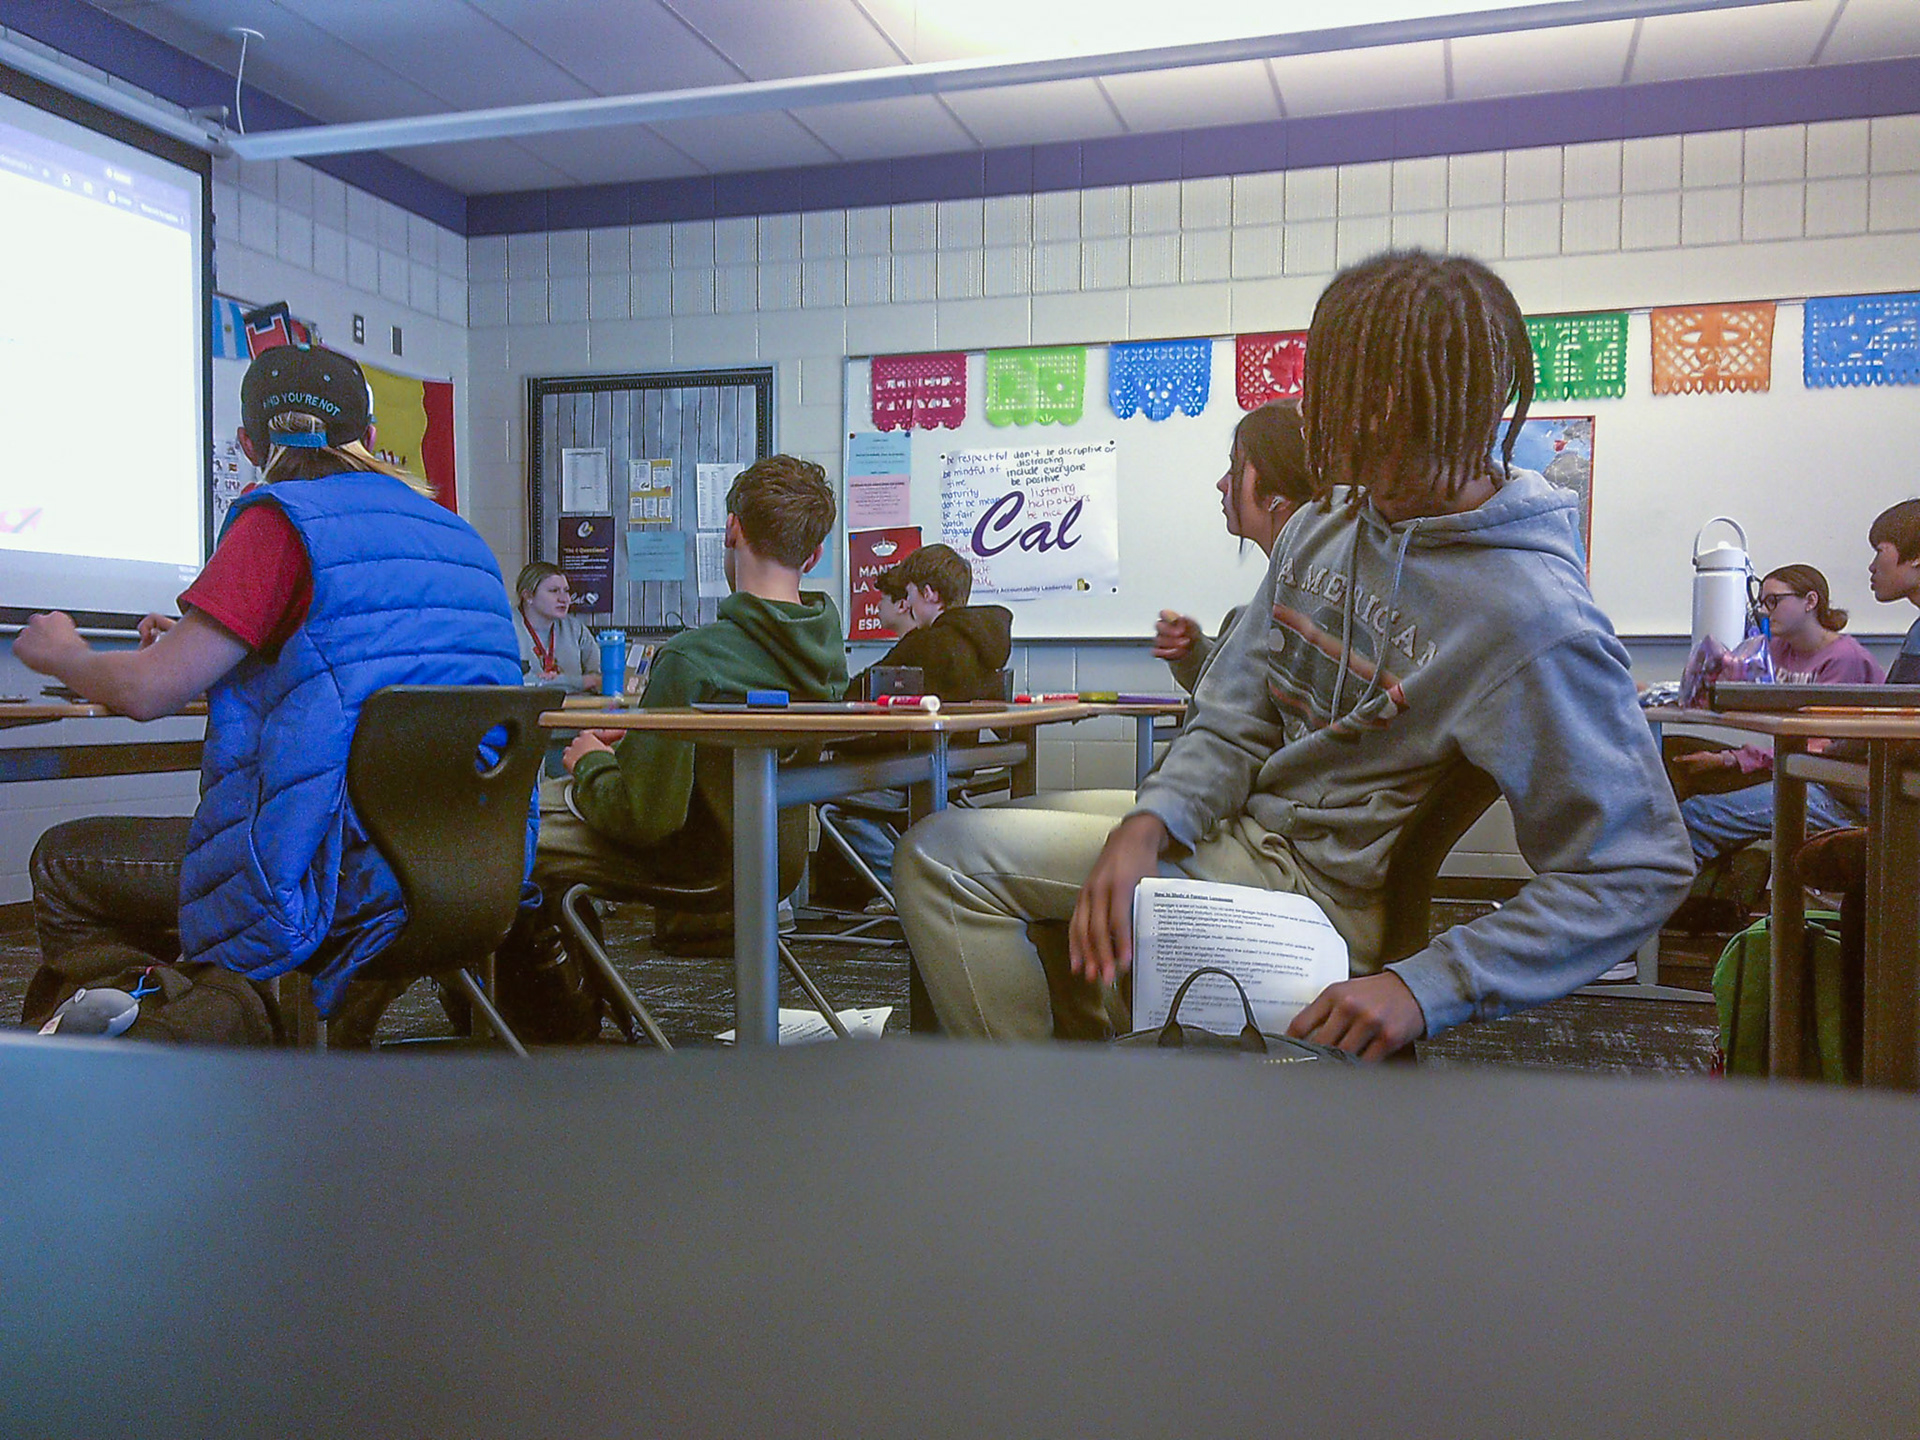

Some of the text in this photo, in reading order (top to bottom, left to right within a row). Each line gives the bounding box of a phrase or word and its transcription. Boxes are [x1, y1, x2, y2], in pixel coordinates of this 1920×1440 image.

[281, 392, 319, 407] YOU'RE
[318, 398, 341, 416] NOT
[958, 451, 1007, 464] respectful
[1013, 449, 1040, 459] don't
[1058, 445, 1102, 456] disruptive
[954, 465, 985, 476] mindful
[1006, 463, 1086, 477] include everyone
[1011, 474, 1060, 486] be positive
[1030, 483, 1076, 497] listening
[971, 490, 1082, 557] Cal
[853, 581, 870, 593] LA
